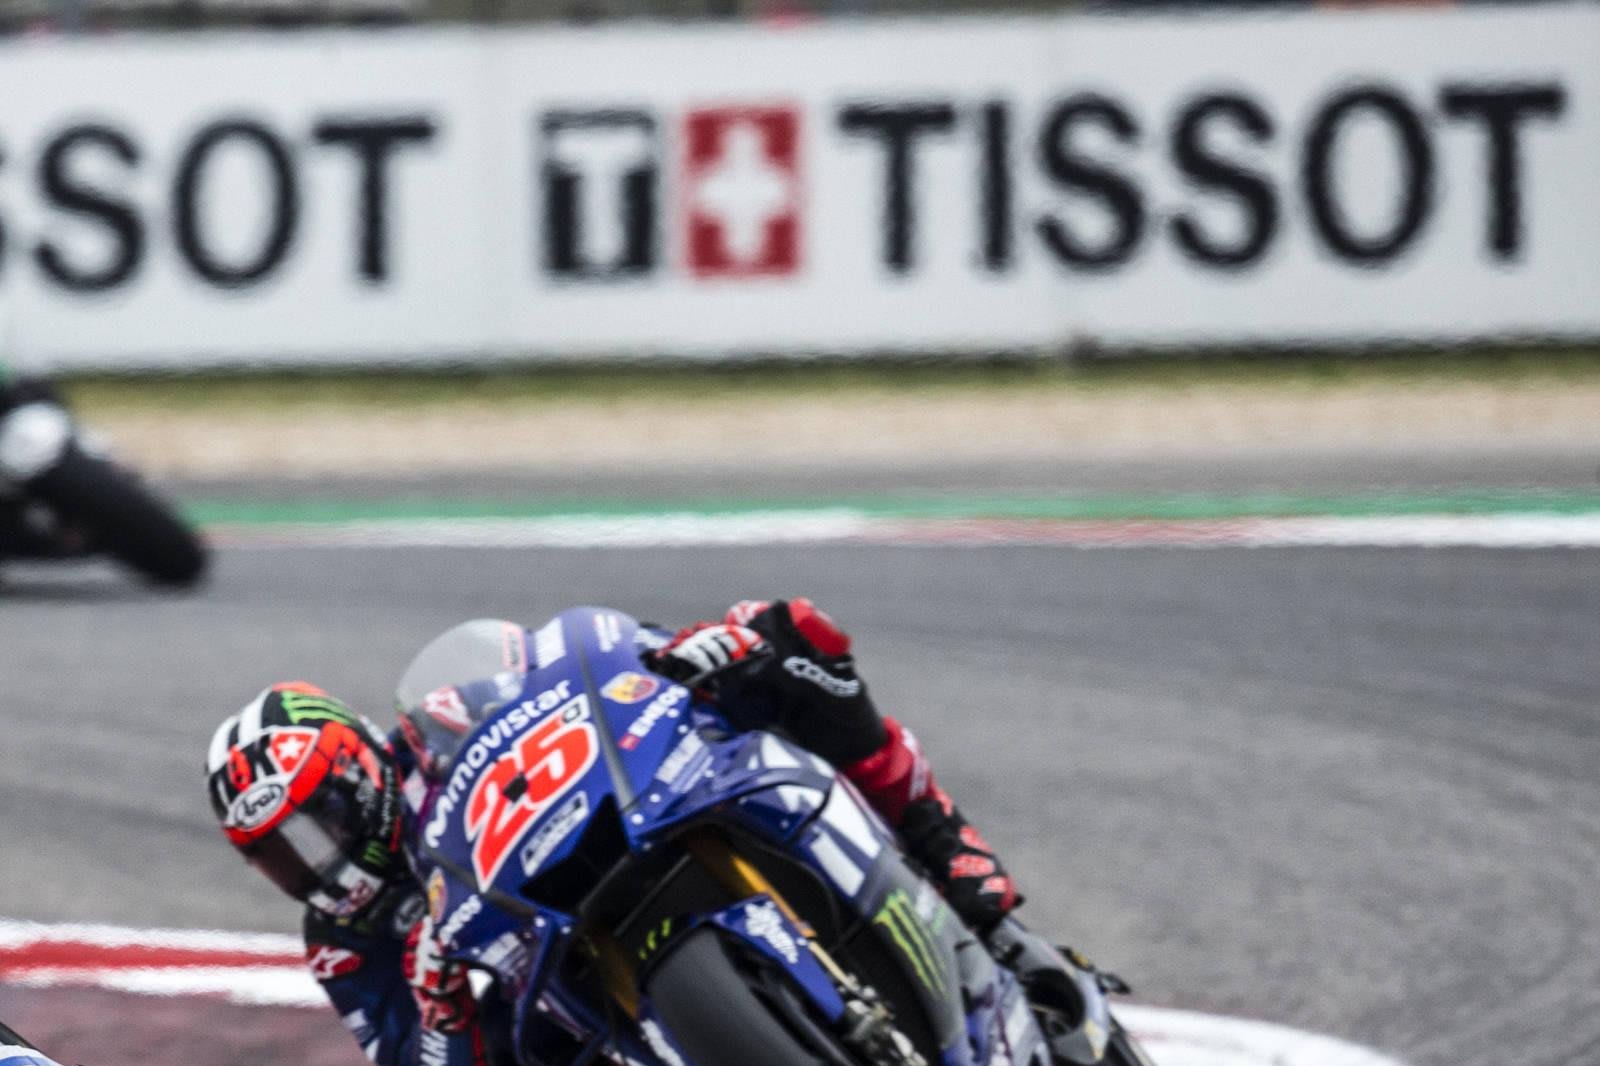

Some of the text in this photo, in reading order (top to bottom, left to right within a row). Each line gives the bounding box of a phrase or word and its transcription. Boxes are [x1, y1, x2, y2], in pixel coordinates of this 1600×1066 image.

[837, 83, 1565, 273] TISSOT
[445, 680, 571, 804] movistar
[466, 711, 598, 891] 25
